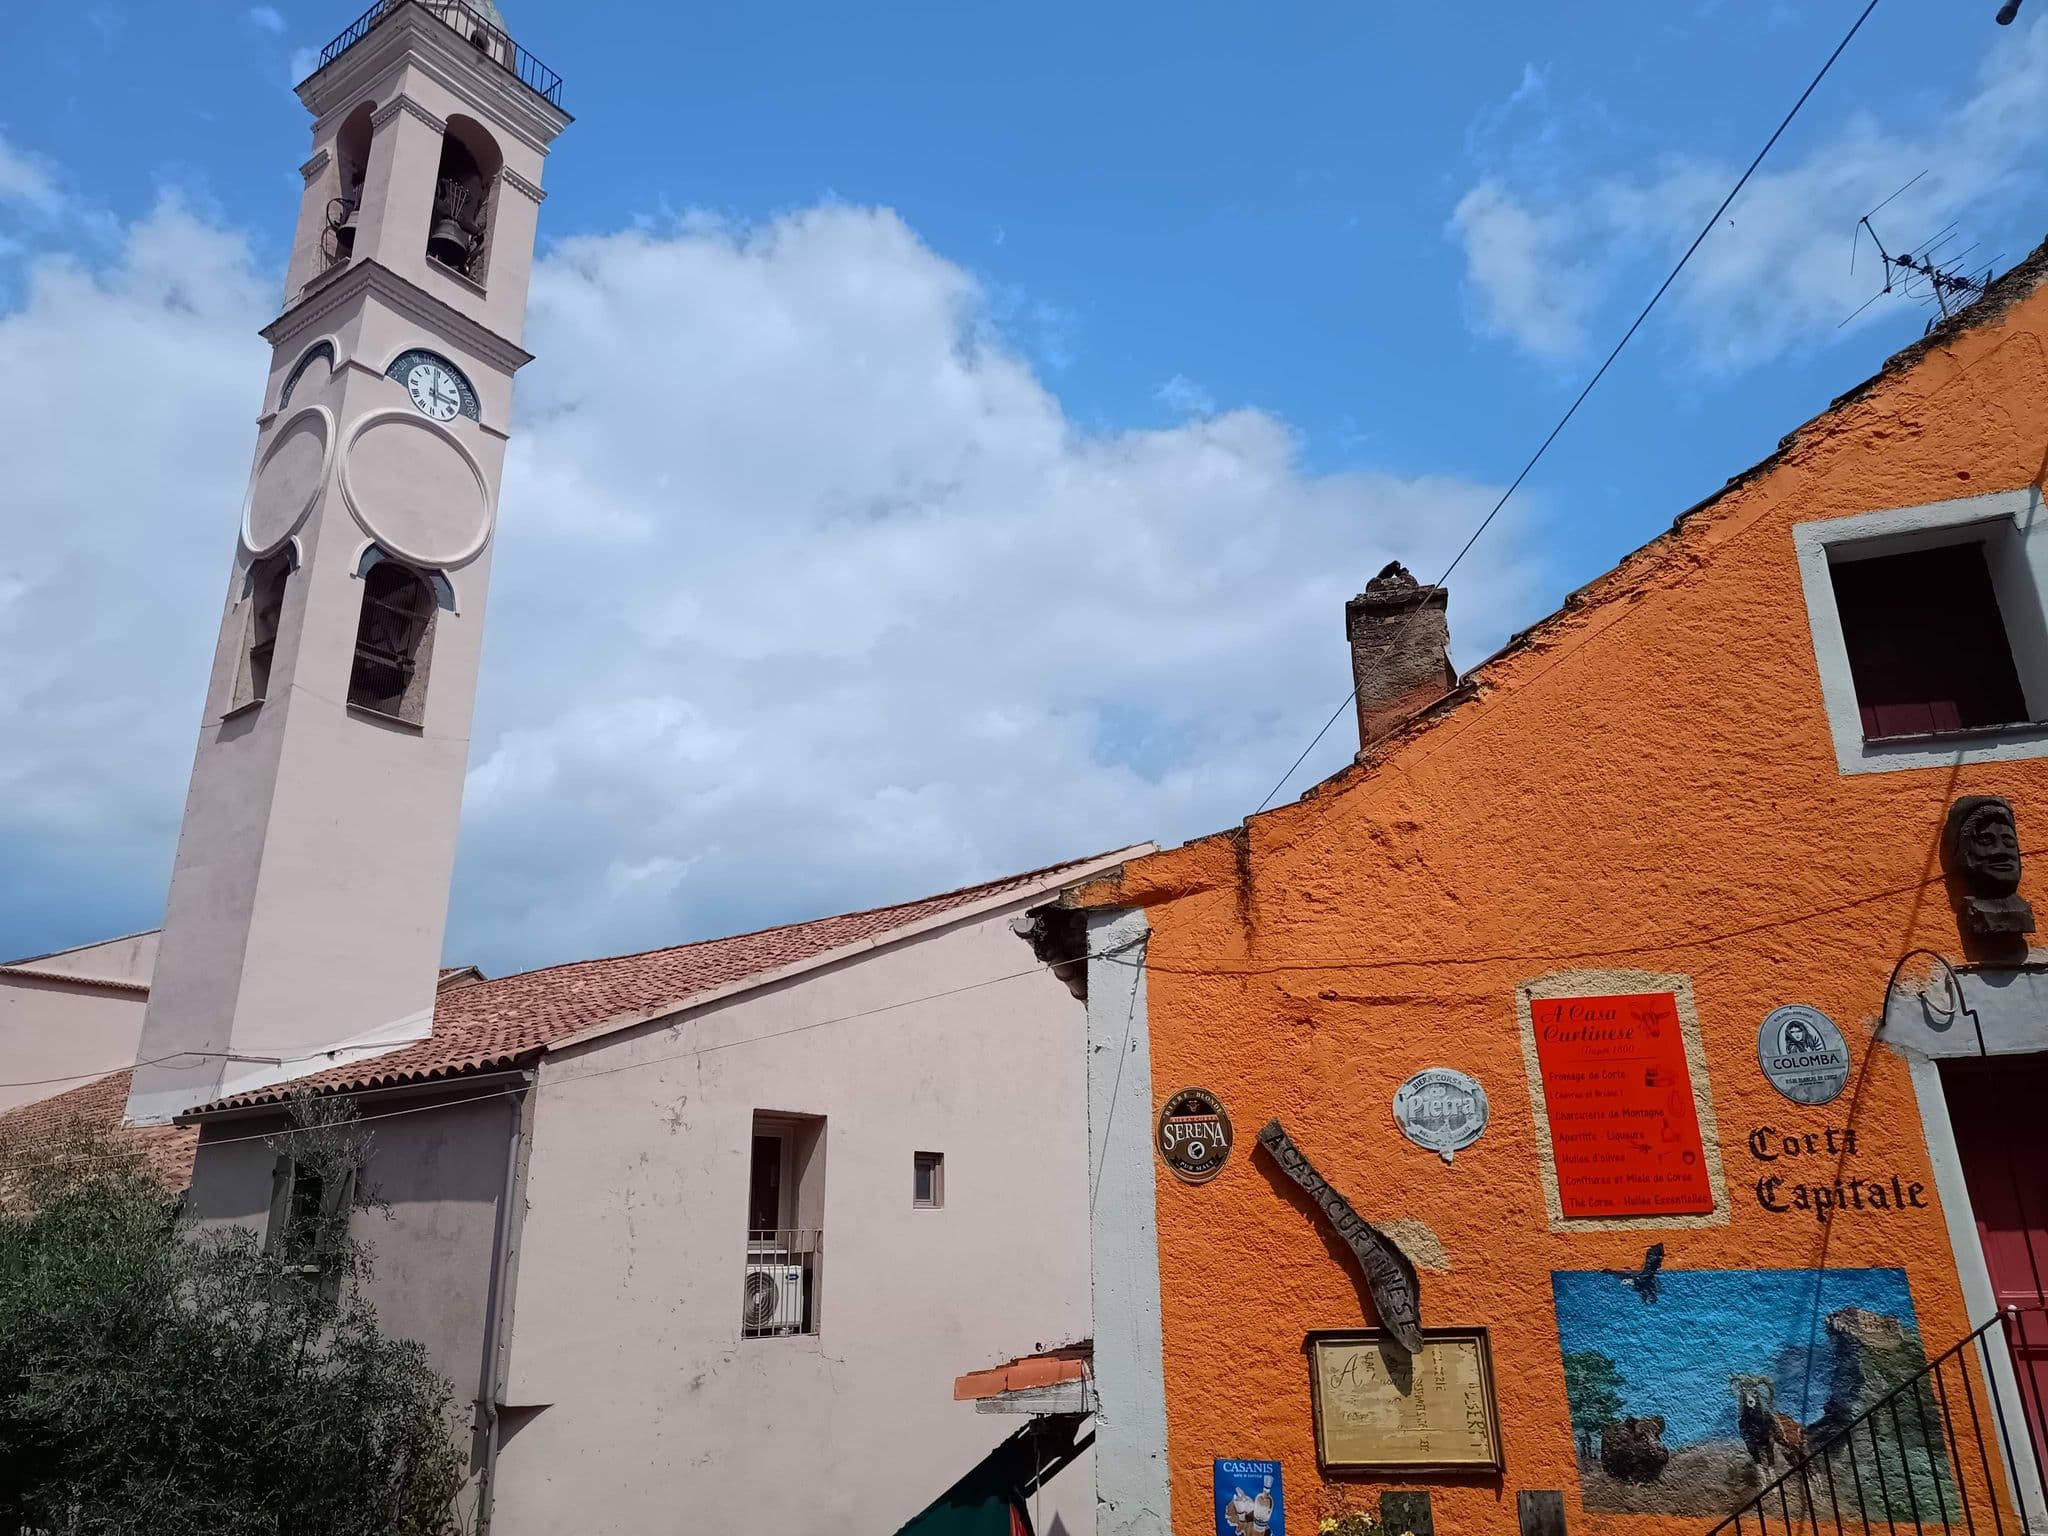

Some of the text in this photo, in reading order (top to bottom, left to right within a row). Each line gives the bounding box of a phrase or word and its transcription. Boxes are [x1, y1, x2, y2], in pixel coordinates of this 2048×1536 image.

[1569, 1004, 1617, 1023] Casa
[1543, 1025, 1634, 1043] Curtinese
[1773, 1053, 1840, 1070] COLOMBA
[1549, 1071, 1586, 1082] Fromage
[1408, 1095, 1476, 1119] Pietra
[1622, 1108, 1665, 1120] Montagne
[1163, 1122, 1228, 1150] SERENA
[1265, 1133, 1284, 1146] A
[1281, 1144, 1329, 1201] CASA
[1756, 1174, 1928, 1223] Capitale
[1222, 1461, 1274, 1474] CASANIS
